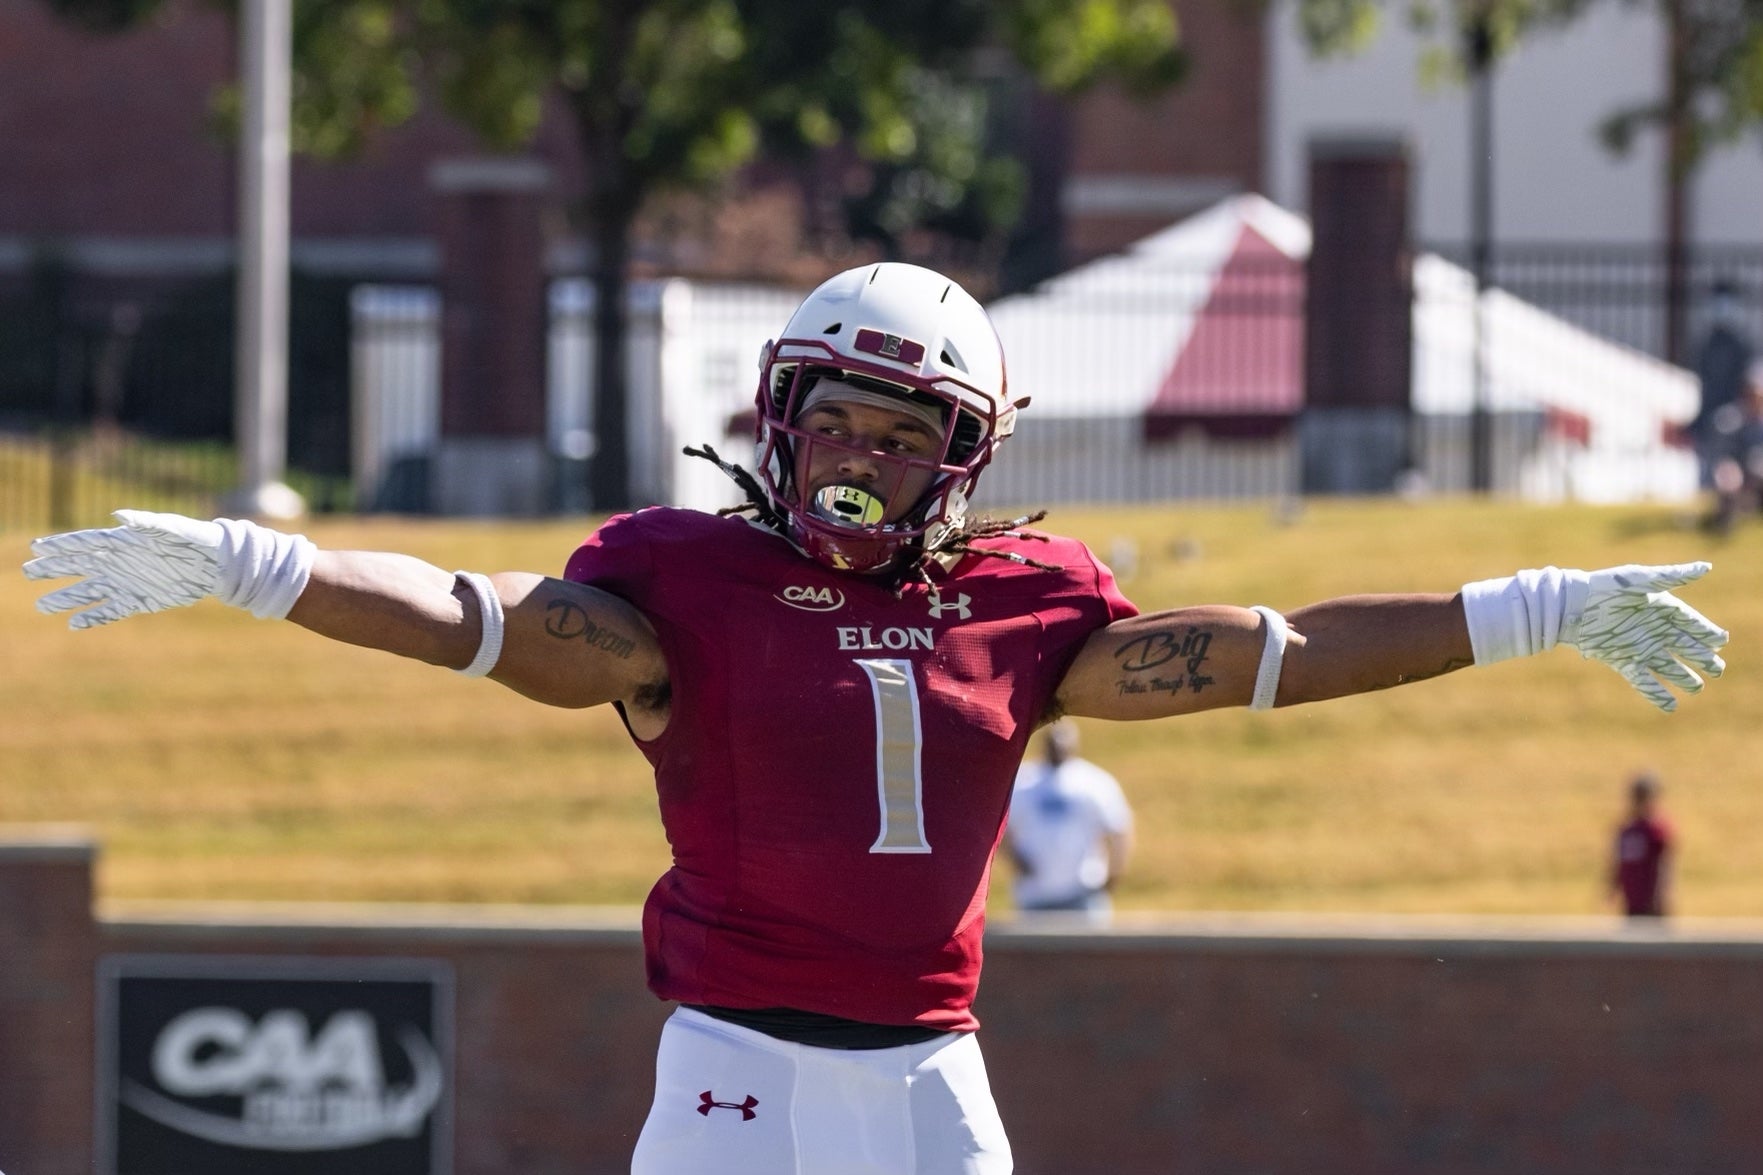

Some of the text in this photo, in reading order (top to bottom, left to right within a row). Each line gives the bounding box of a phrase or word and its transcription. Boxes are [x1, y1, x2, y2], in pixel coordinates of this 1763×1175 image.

[783, 585, 834, 604] CAA
[545, 599, 637, 659] Dream
[836, 626, 934, 650] ELON
[1114, 626, 1213, 674] Big
[852, 658, 932, 854] 1
[152, 1006, 384, 1098] CAA
